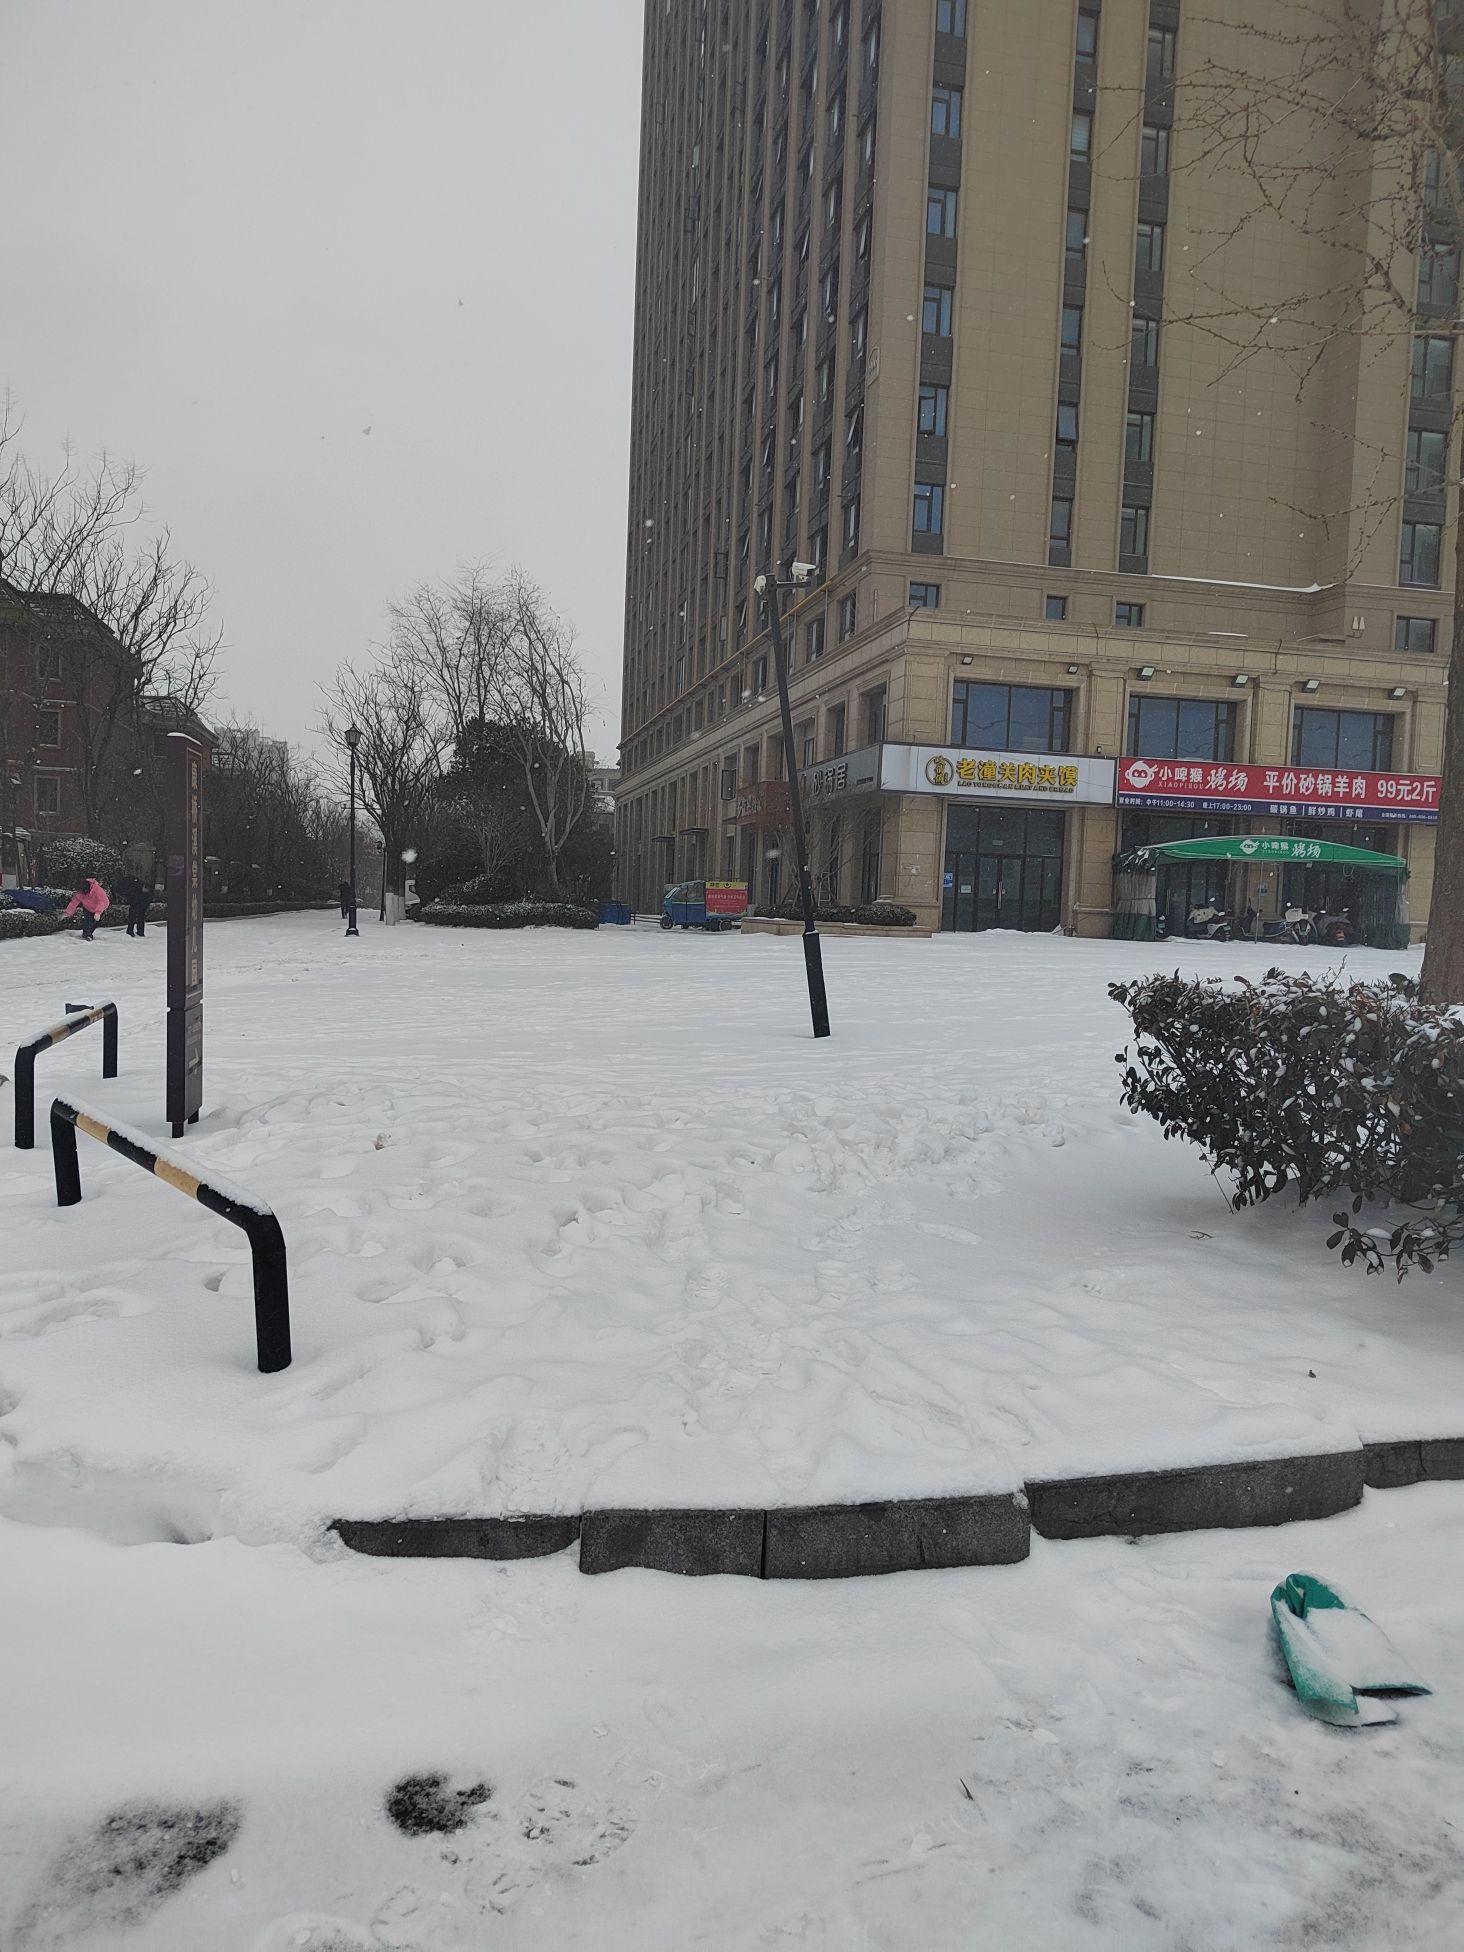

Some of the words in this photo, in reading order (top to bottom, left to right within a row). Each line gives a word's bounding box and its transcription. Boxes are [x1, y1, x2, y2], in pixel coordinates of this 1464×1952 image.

[813, 762, 848, 796] 砂锅居
[957, 757, 1079, 787] 老潼关肉夹馍
[1158, 766, 1203, 783] 小啤猴
[1205, 766, 1249, 792] 烤场
[1263, 770, 1366, 799] 平价砂锅羊肉
[1377, 779, 1437, 803] 99元2斤
